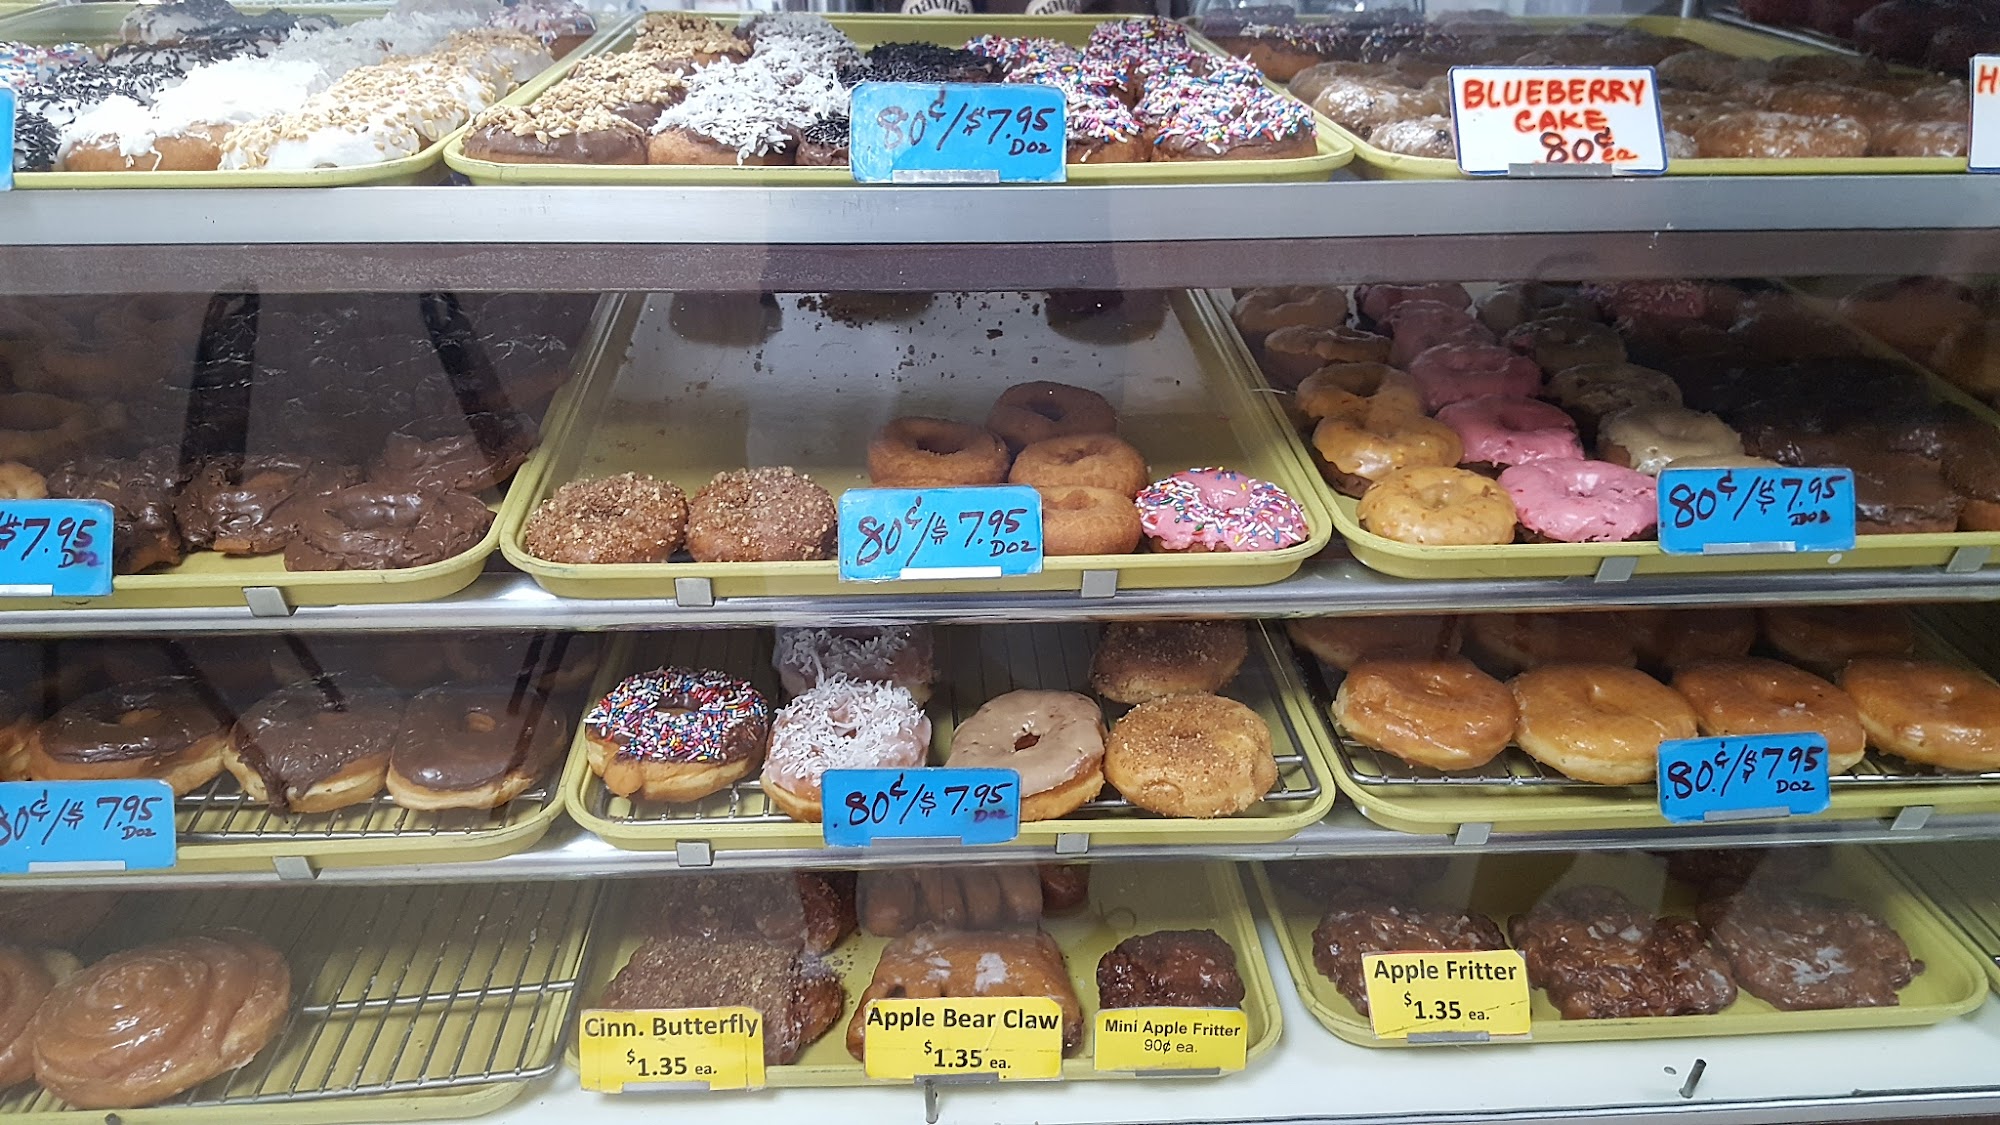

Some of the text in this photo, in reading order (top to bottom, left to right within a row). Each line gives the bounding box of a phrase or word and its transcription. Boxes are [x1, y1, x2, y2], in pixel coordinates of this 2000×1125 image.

[1463, 78, 1646, 109] BLUEBERRY
[1514, 109, 1608, 133] CAKE
[1373, 959, 1517, 984] Apple Fritter
[1403, 991, 1490, 1020] $1.35 ea.
[584, 1013, 759, 1038] Cinn. Butterfly
[866, 1006, 1060, 1031] Apple Bear Claw
[1105, 1018, 1241, 1037] Mini Apple Fritter
[924, 1039, 1011, 1069] $1.35 ea.
[1144, 1038, 1198, 1054] 90¢ ea.
[626, 1048, 718, 1077] $1.35 ea.
